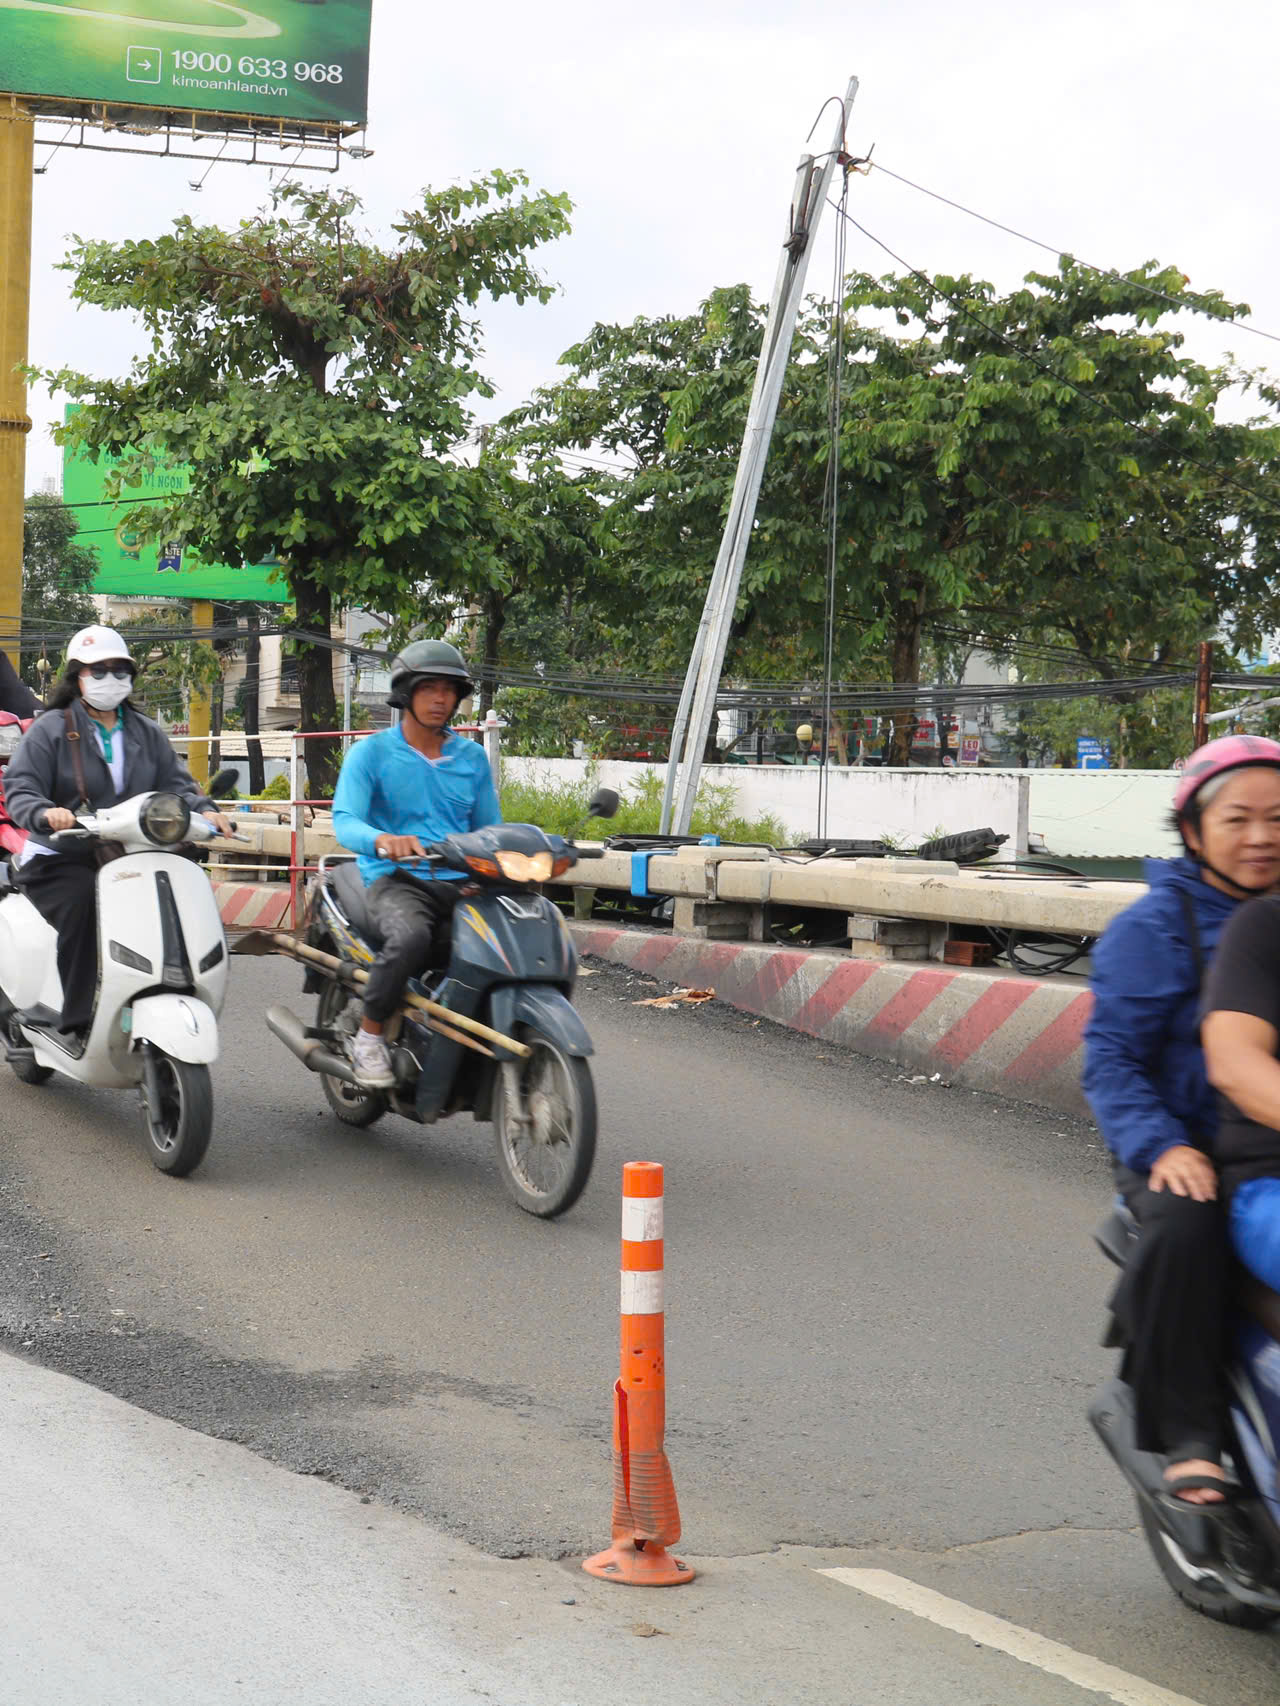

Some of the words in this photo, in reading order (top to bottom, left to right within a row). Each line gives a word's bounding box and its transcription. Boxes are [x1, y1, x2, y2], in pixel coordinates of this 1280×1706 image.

[171, 49, 232, 74] 1900
[238, 55, 287, 79] 633
[294, 61, 343, 84] 968
[172, 74, 288, 97] kimoanhland.vn
